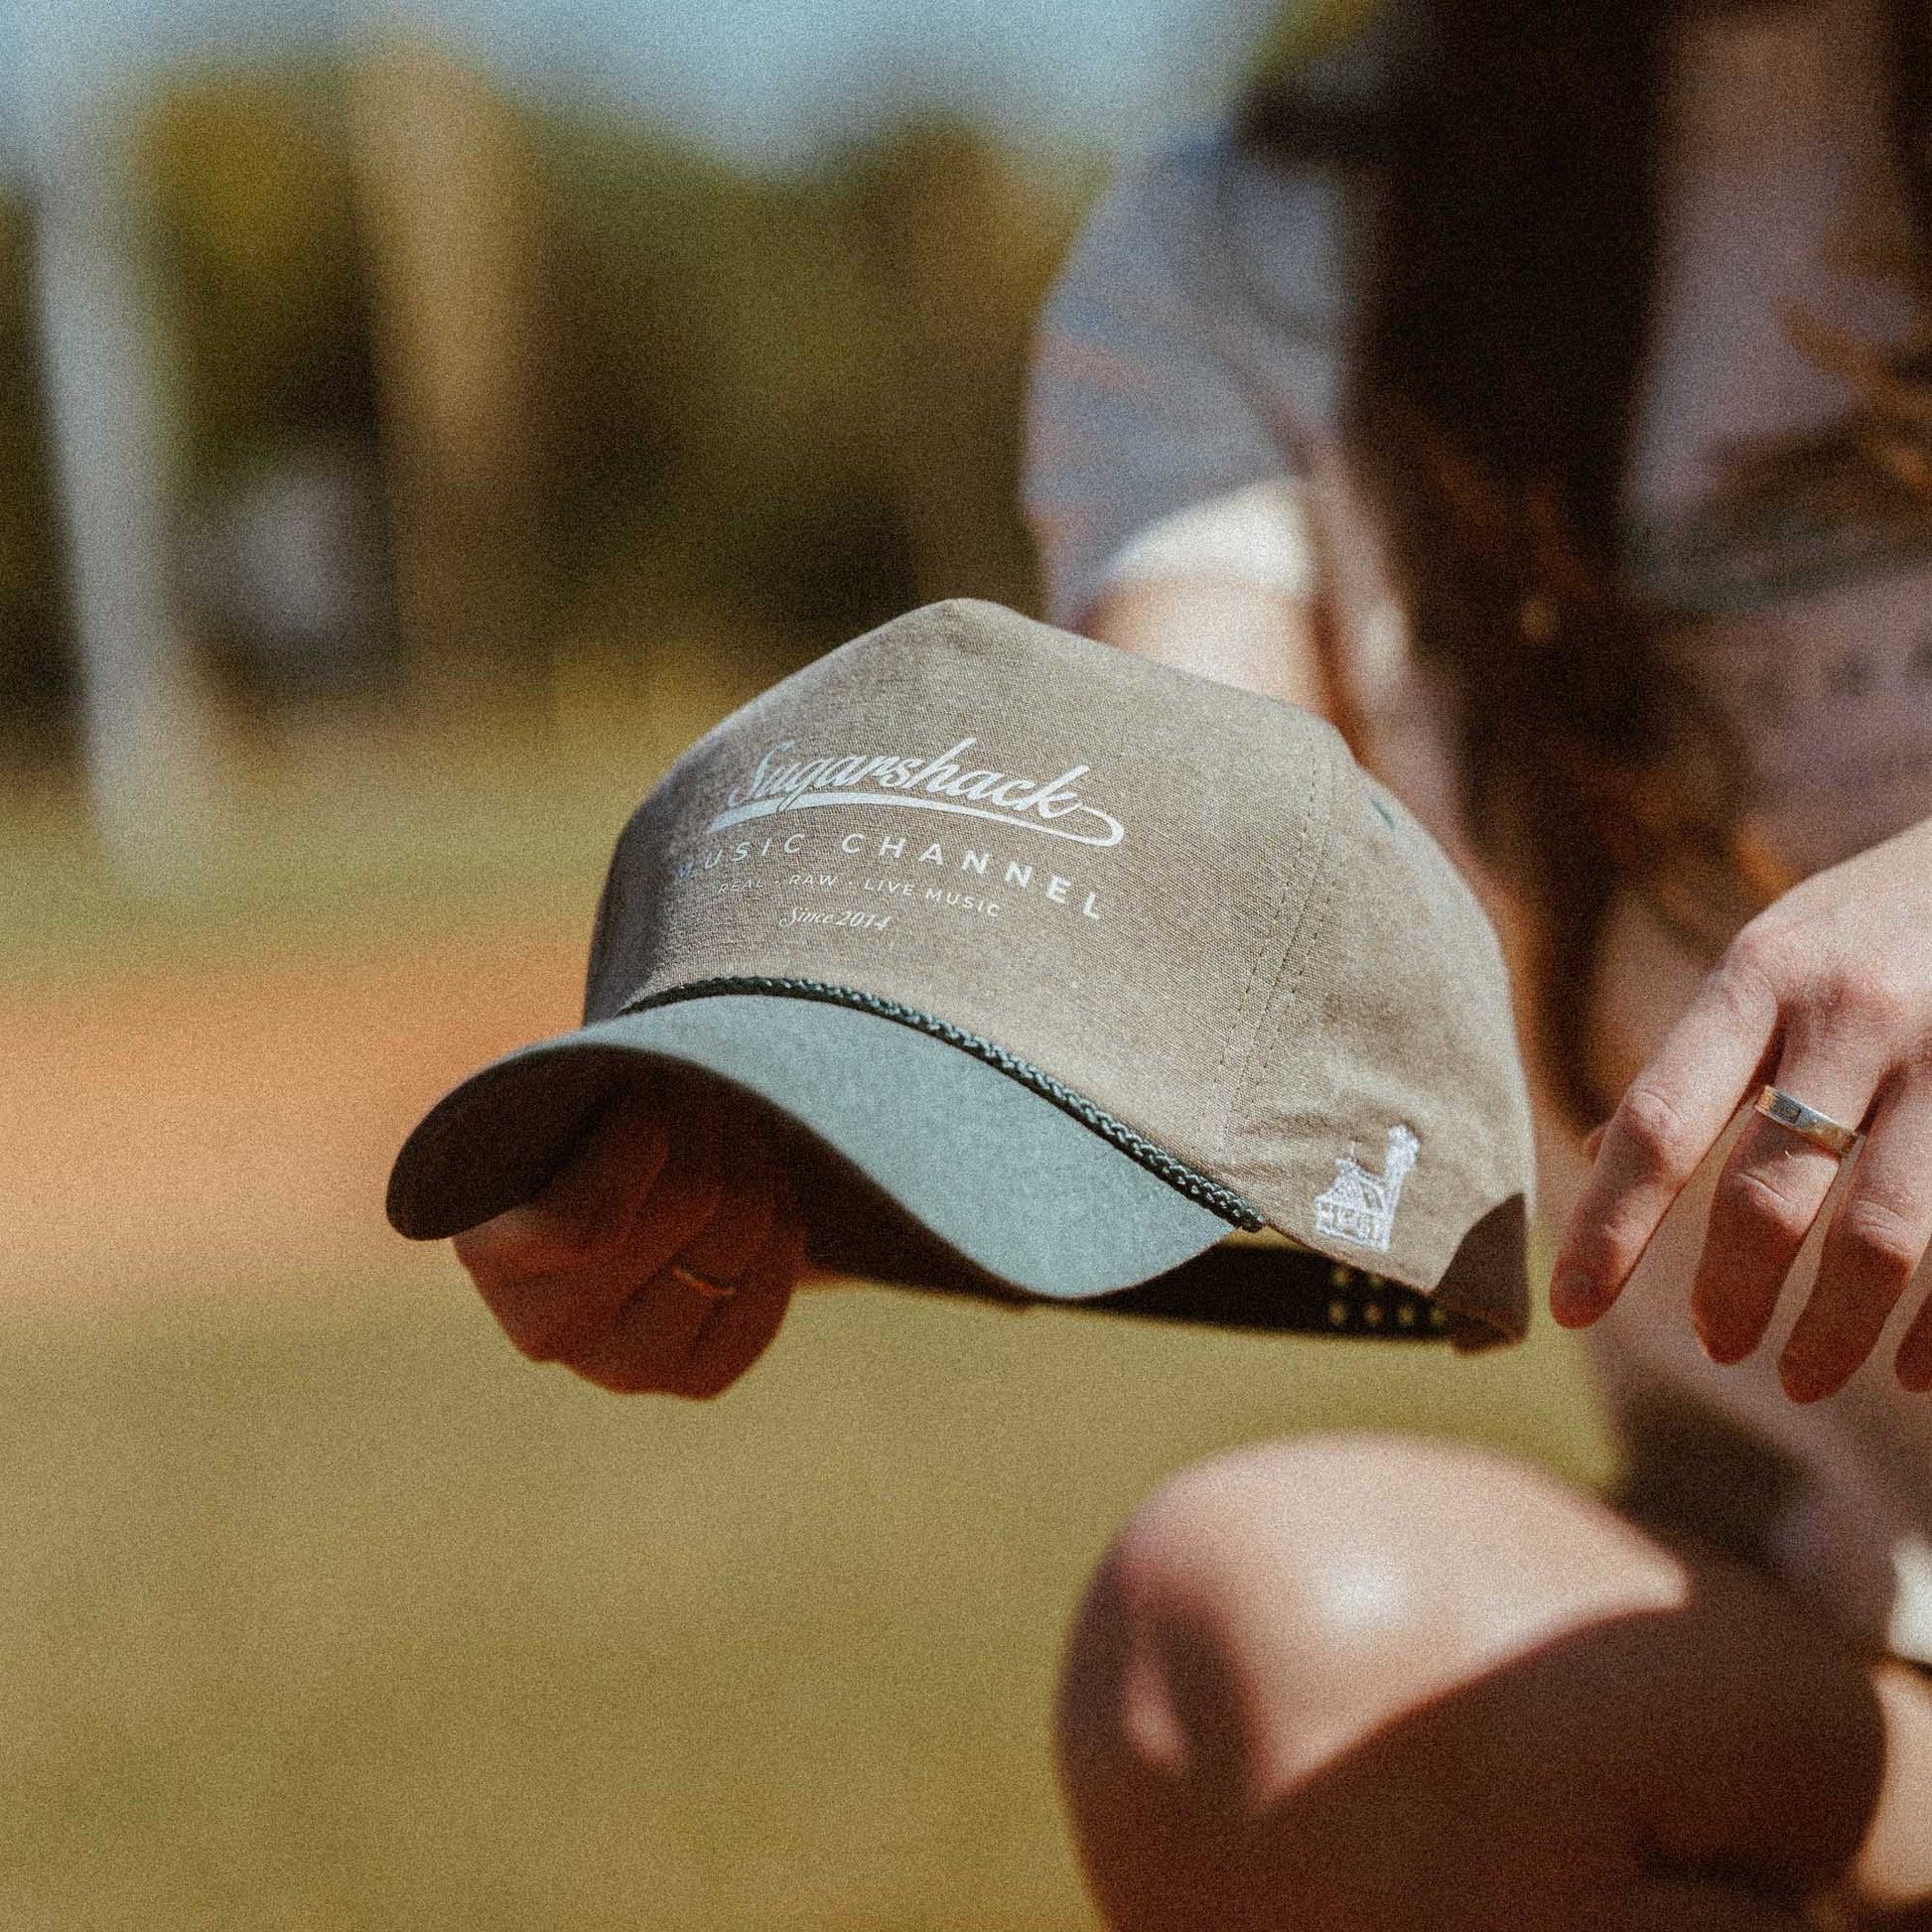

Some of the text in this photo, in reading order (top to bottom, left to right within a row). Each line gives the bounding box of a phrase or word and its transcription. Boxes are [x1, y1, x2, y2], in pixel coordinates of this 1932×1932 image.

[722, 737, 1100, 826] Sugarshack
[717, 874, 1001, 918] REAL RAW LIVE MUSIC
[841, 832, 1102, 920] CHANNEL
[778, 906, 892, 930] Since 2014
